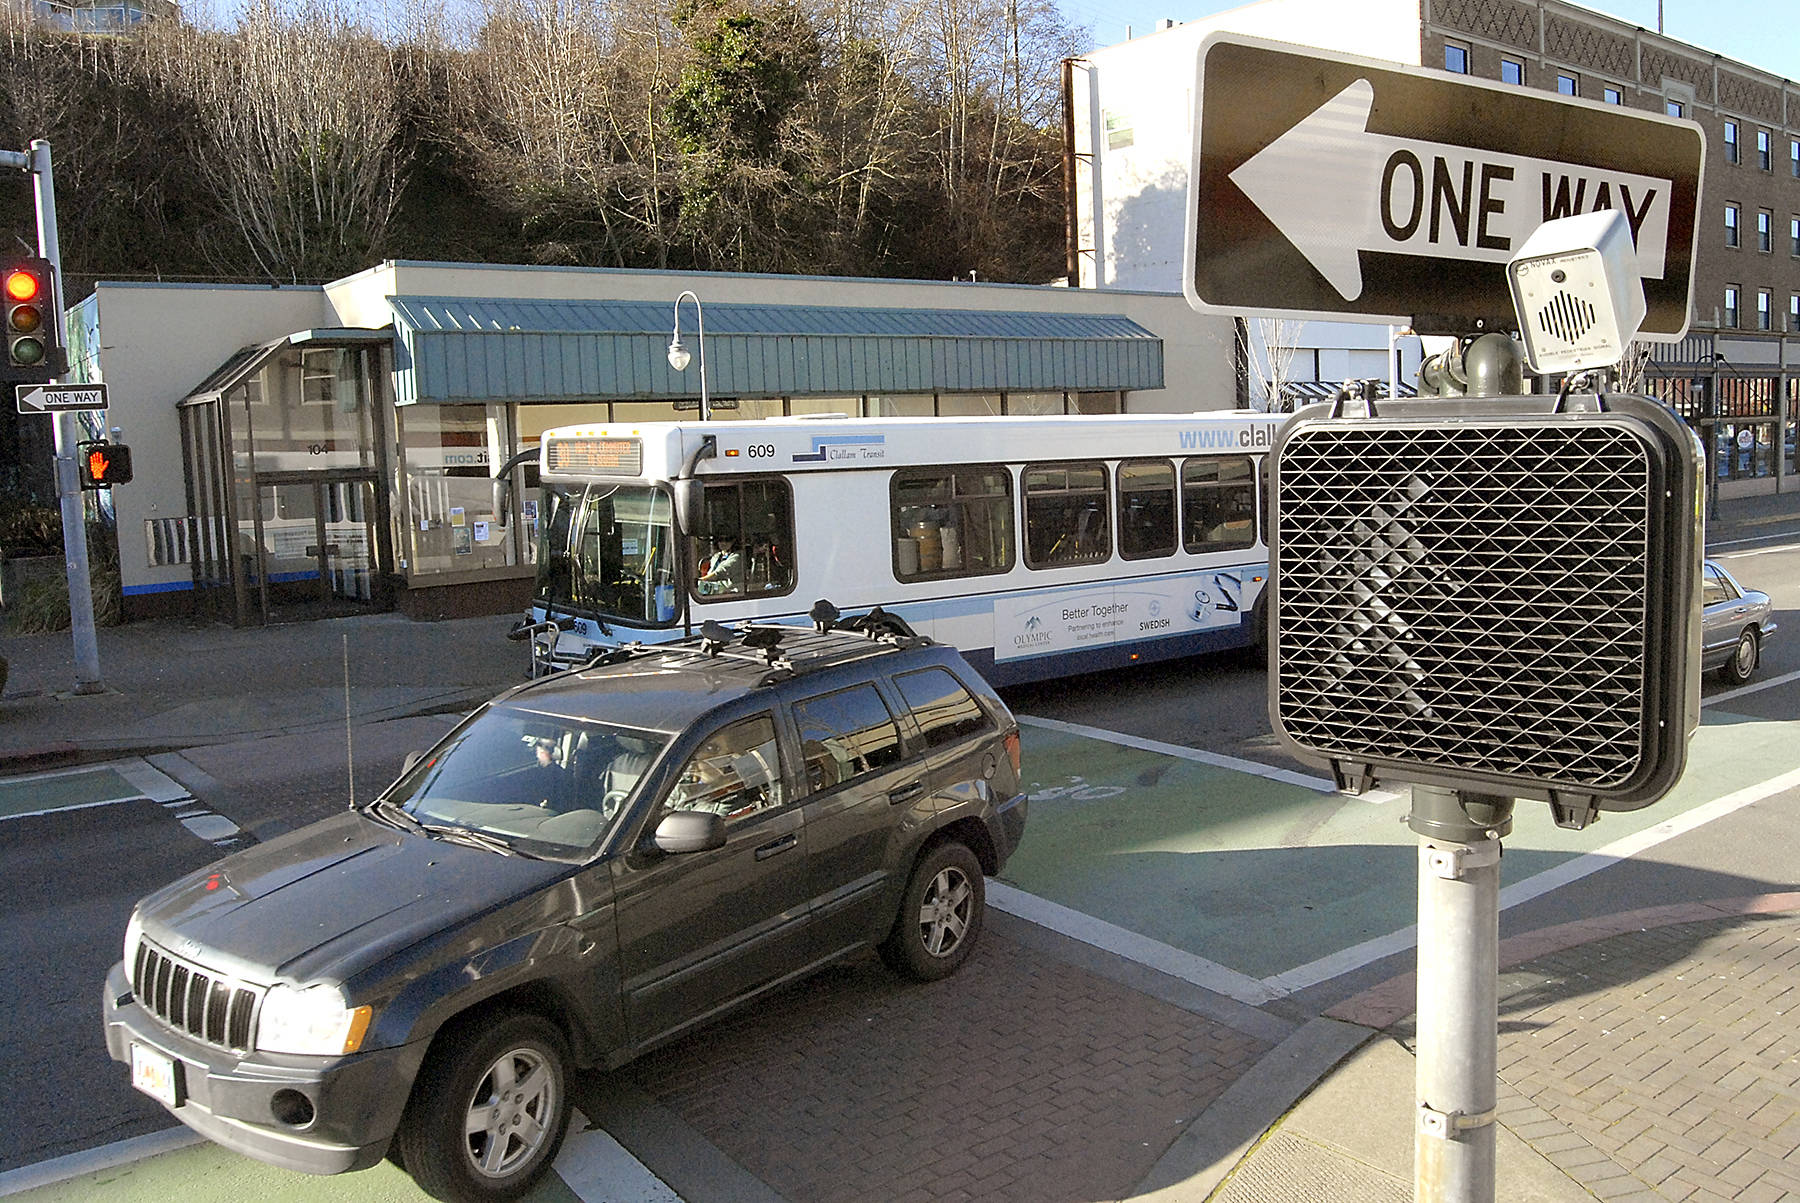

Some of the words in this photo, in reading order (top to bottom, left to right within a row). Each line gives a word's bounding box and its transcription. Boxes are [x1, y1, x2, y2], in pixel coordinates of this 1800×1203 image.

[1381, 149, 1515, 251] ONE
[45, 392, 69, 404] ONE
[74, 392, 98, 403] WAY
[307, 444, 328, 456] 104
[747, 444, 775, 459] 609
[830, 449, 857, 461] Clallam
[860, 448, 885, 459] Transit
[1062, 609, 1089, 621] Better
[1092, 603, 1129, 618] Together
[1139, 618, 1171, 631] SWEDISH
[1014, 630, 1053, 646] OLYMPIC
